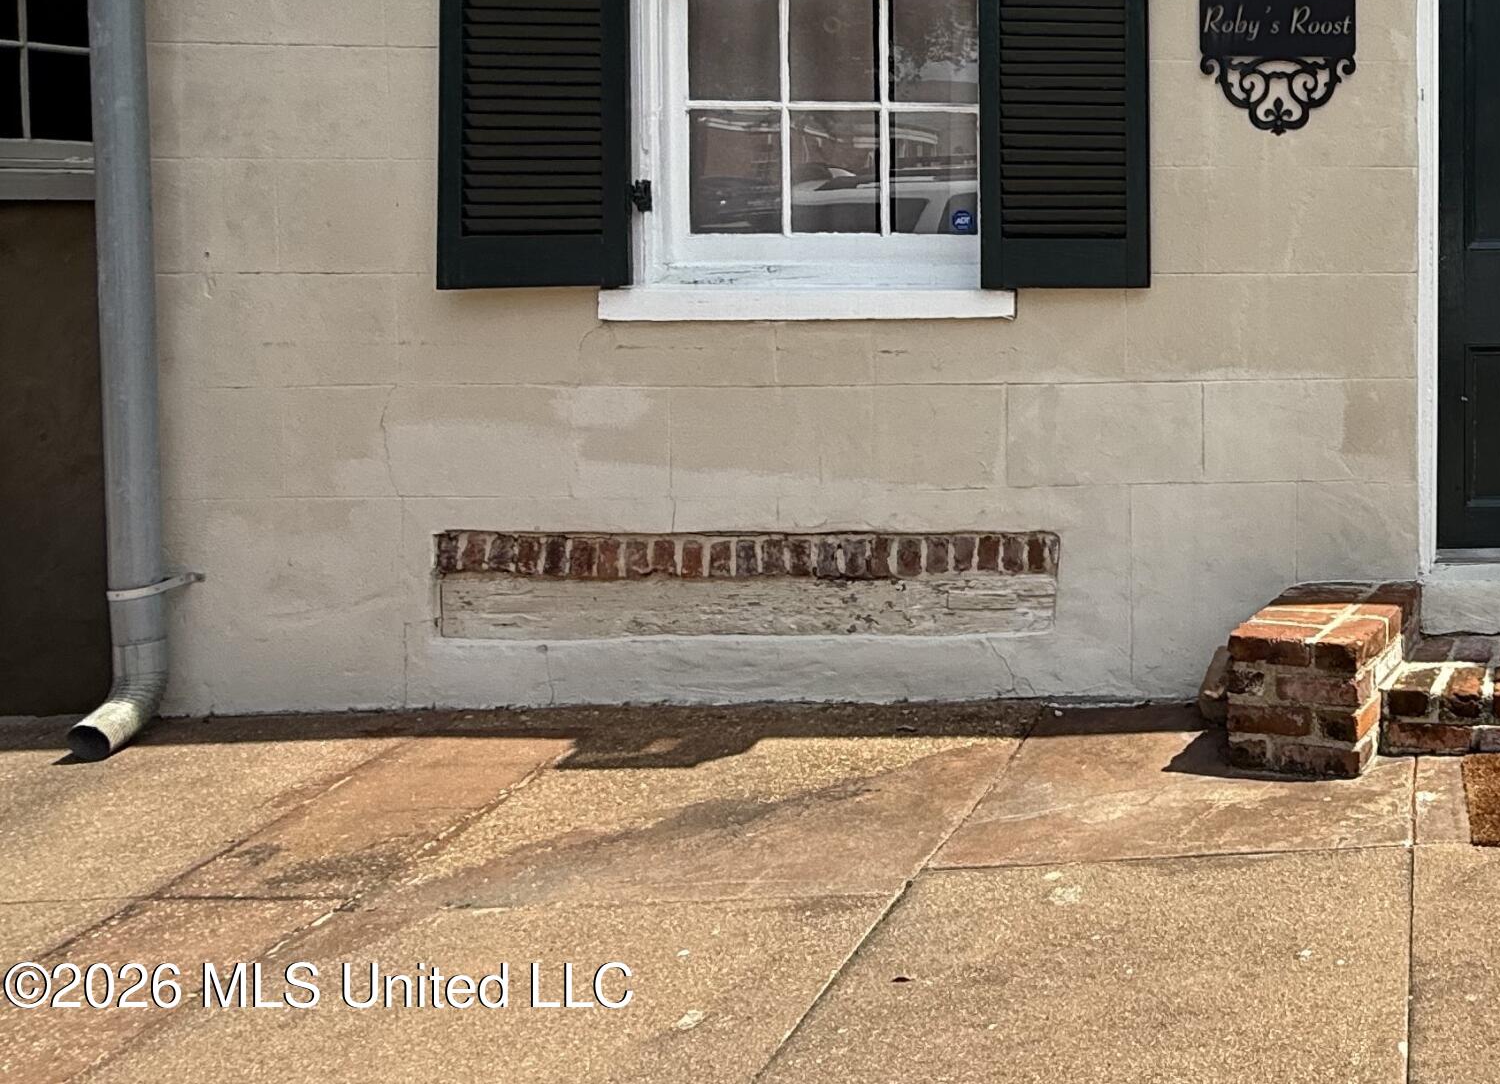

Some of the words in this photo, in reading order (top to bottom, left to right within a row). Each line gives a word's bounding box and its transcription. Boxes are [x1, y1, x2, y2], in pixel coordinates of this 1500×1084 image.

[1203, 4, 1280, 41] Roby's
[1290, 5, 1351, 35] Roost
[954, 216, 971, 225] ADT
